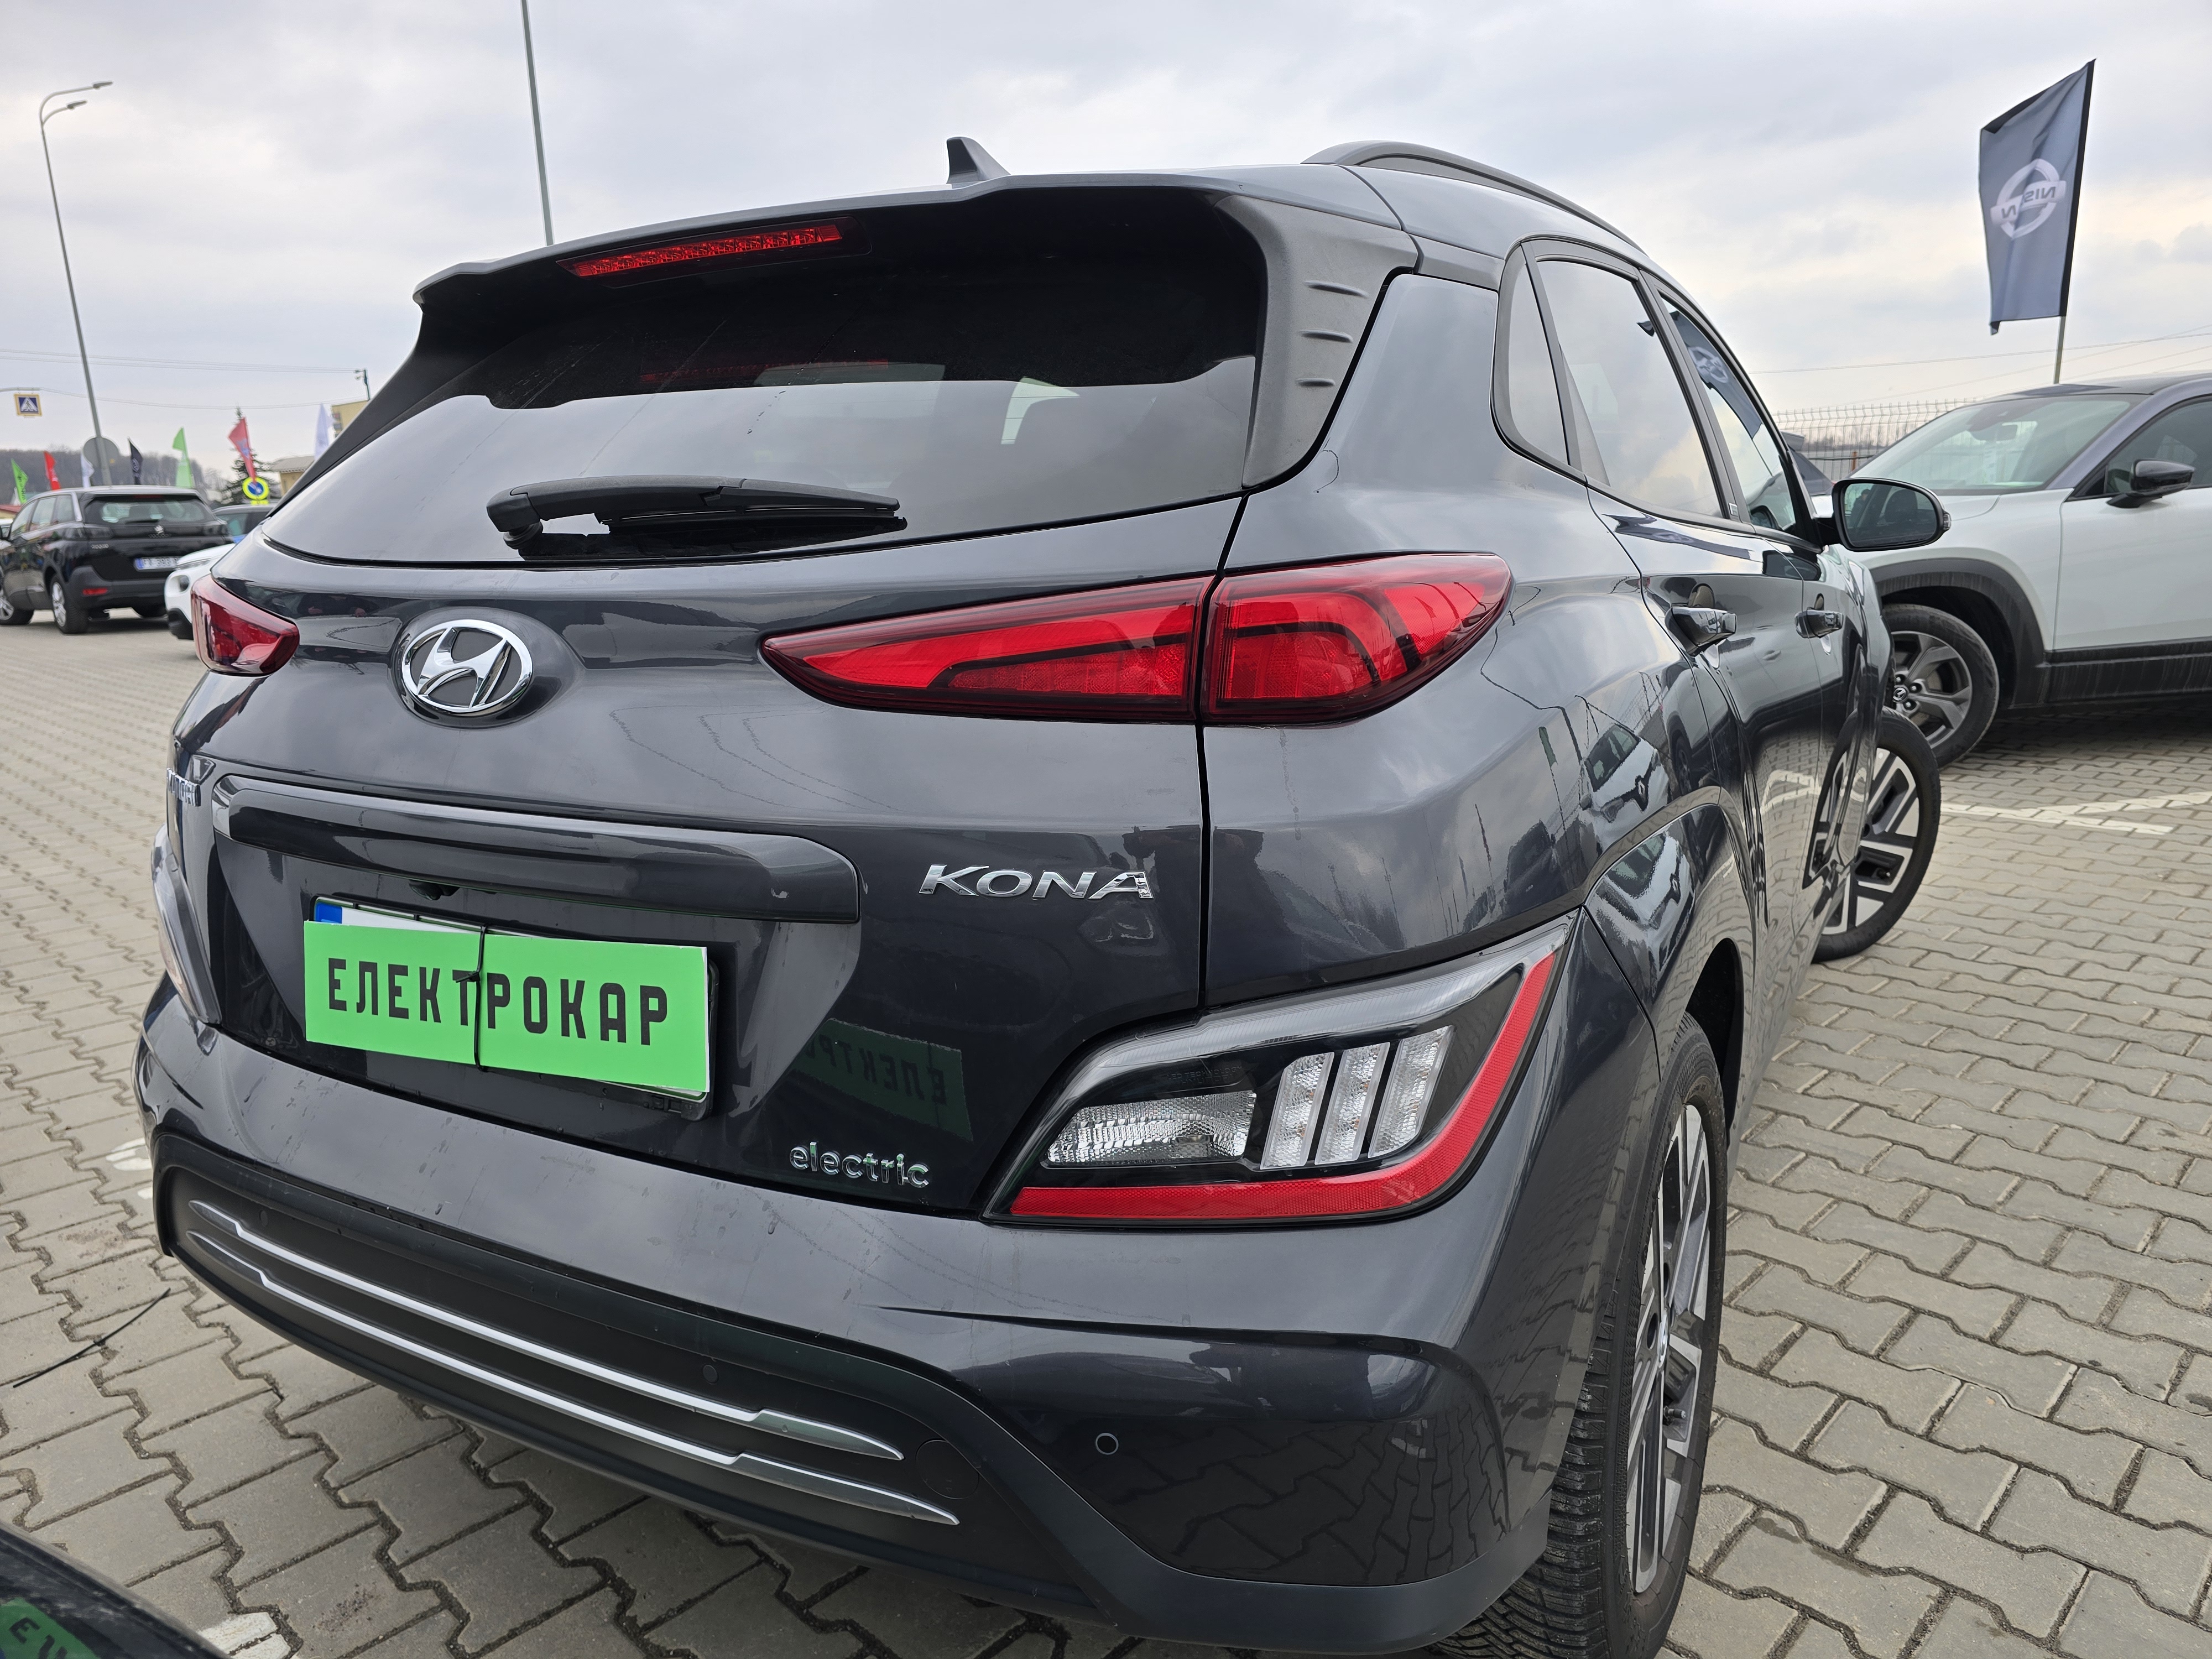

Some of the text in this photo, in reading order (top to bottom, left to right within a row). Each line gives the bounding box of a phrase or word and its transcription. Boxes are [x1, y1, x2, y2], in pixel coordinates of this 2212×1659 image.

[918, 864, 1154, 900] KONA
[328, 957, 667, 1046] ЕЛЕКТРОКАР
[789, 1141, 930, 1189] electric
